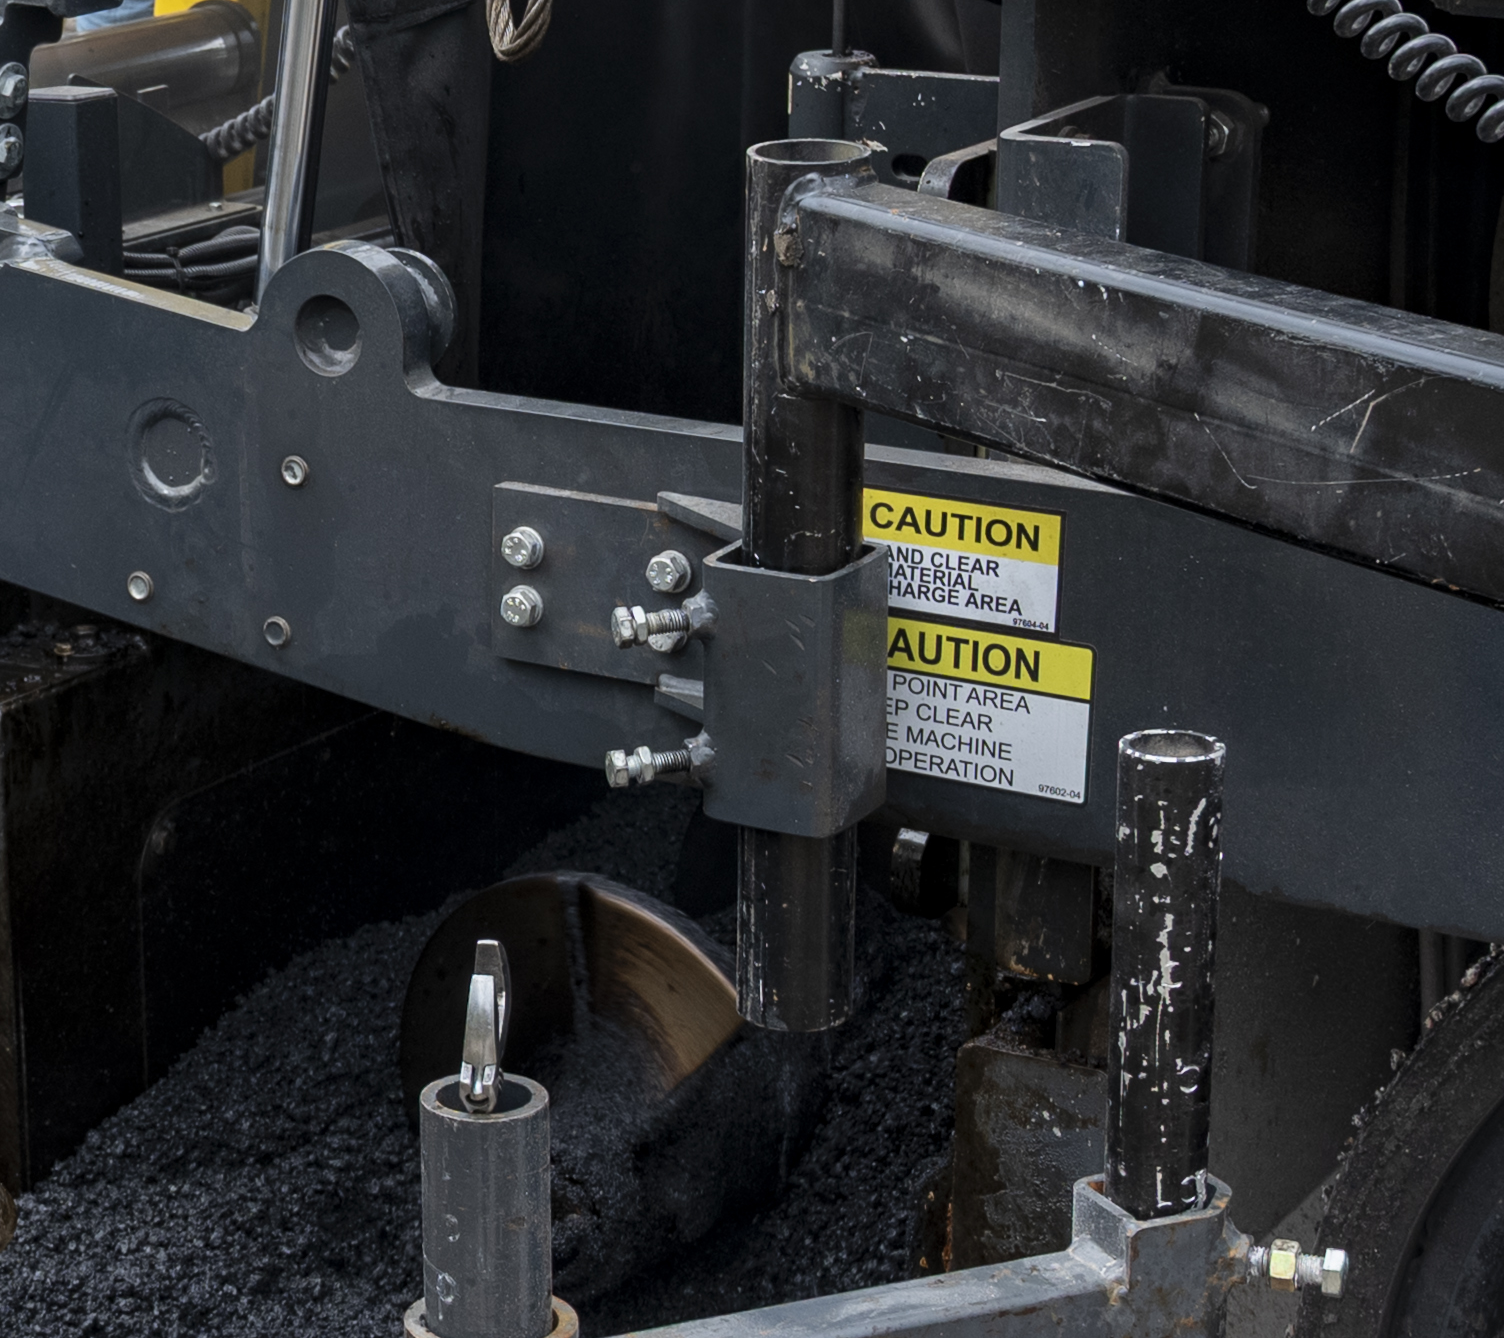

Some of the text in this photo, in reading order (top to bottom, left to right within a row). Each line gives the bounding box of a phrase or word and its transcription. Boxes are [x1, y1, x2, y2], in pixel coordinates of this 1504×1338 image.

[869, 502, 1040, 553] CAUTION
[887, 545, 1000, 578] AND CLEAR
[889, 579, 1023, 616] HARGE AREA
[887, 627, 1041, 683] AUTION
[892, 673, 1031, 714] POINT AREA
[916, 703, 993, 733] CLEAR
[906, 725, 1013, 762] MACHINE
[886, 746, 1014, 787] OPERATION
[1038, 783, 1081, 799] 97602-04
